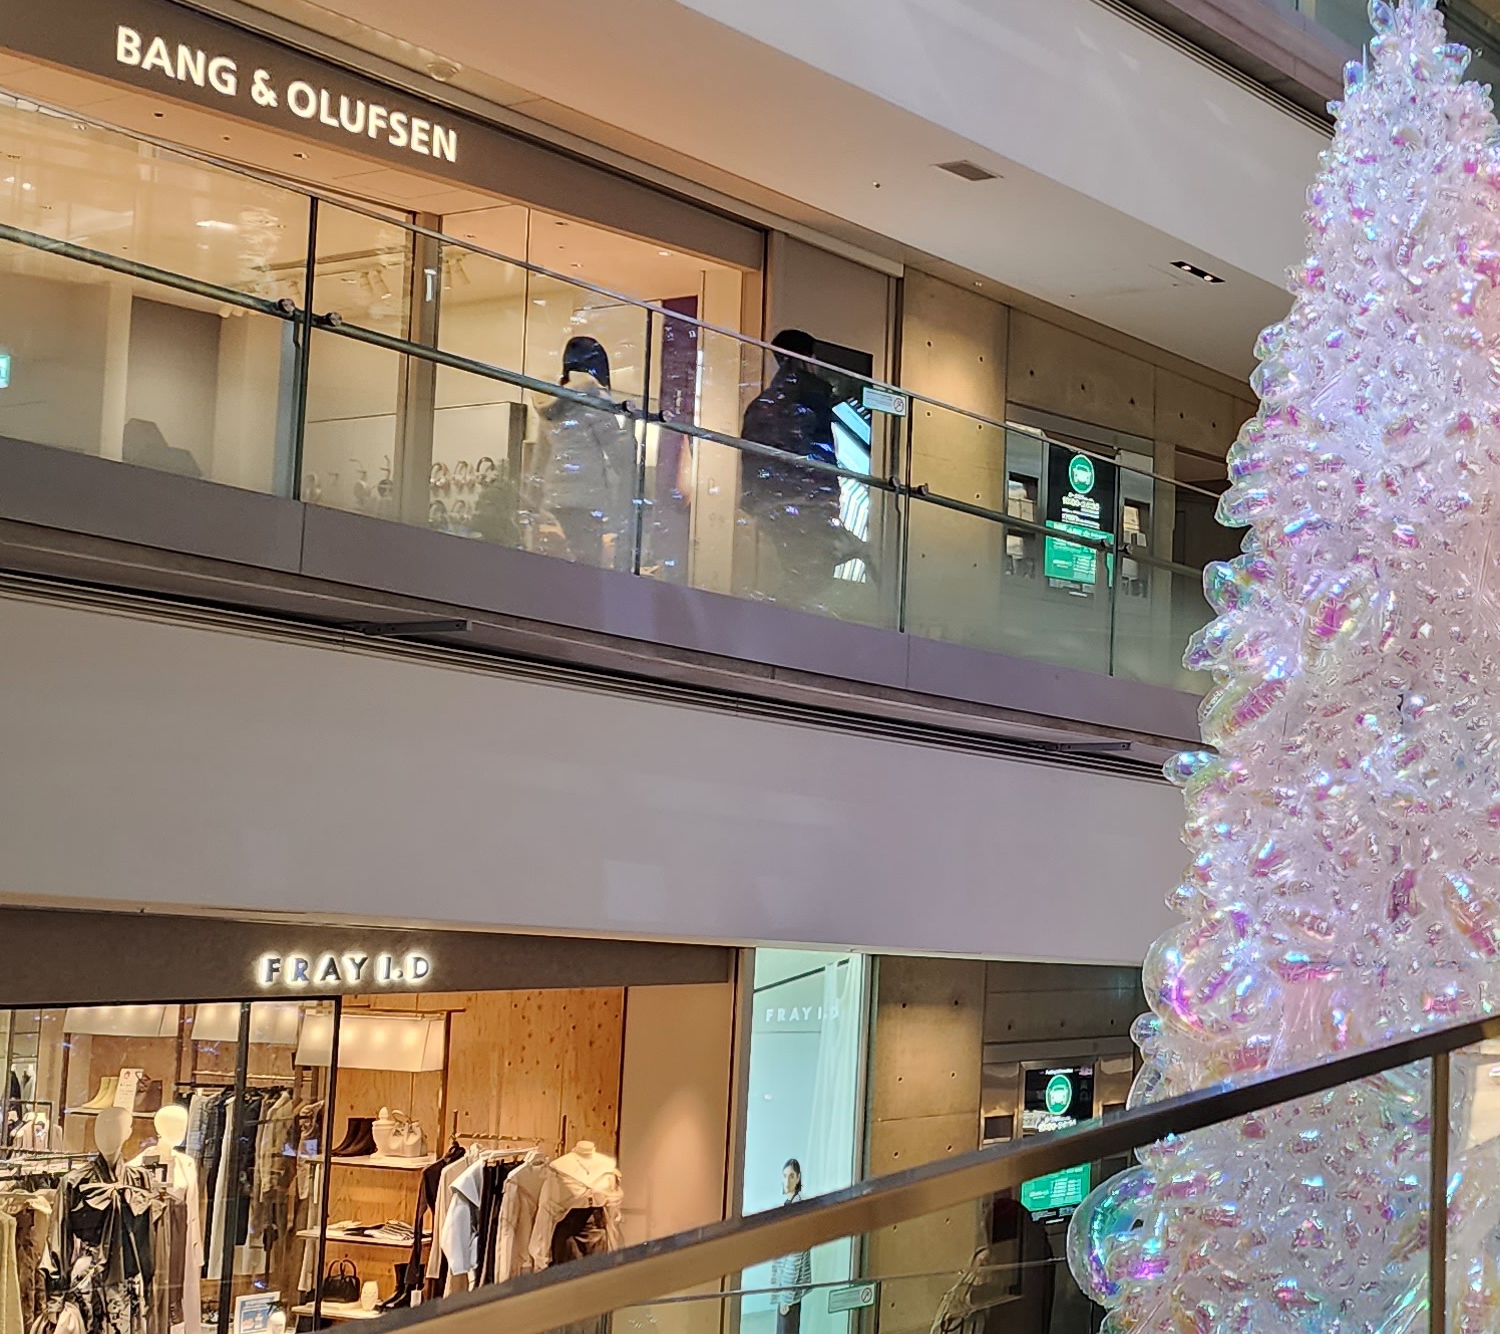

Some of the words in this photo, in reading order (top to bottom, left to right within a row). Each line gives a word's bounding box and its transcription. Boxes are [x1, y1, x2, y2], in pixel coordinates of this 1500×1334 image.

[115, 24, 238, 96] BANG
[250, 68, 278, 108] &
[287, 80, 458, 163] OLUFSEN
[261, 954, 369, 984] FRAY
[765, 1006, 812, 1023] FRAY
